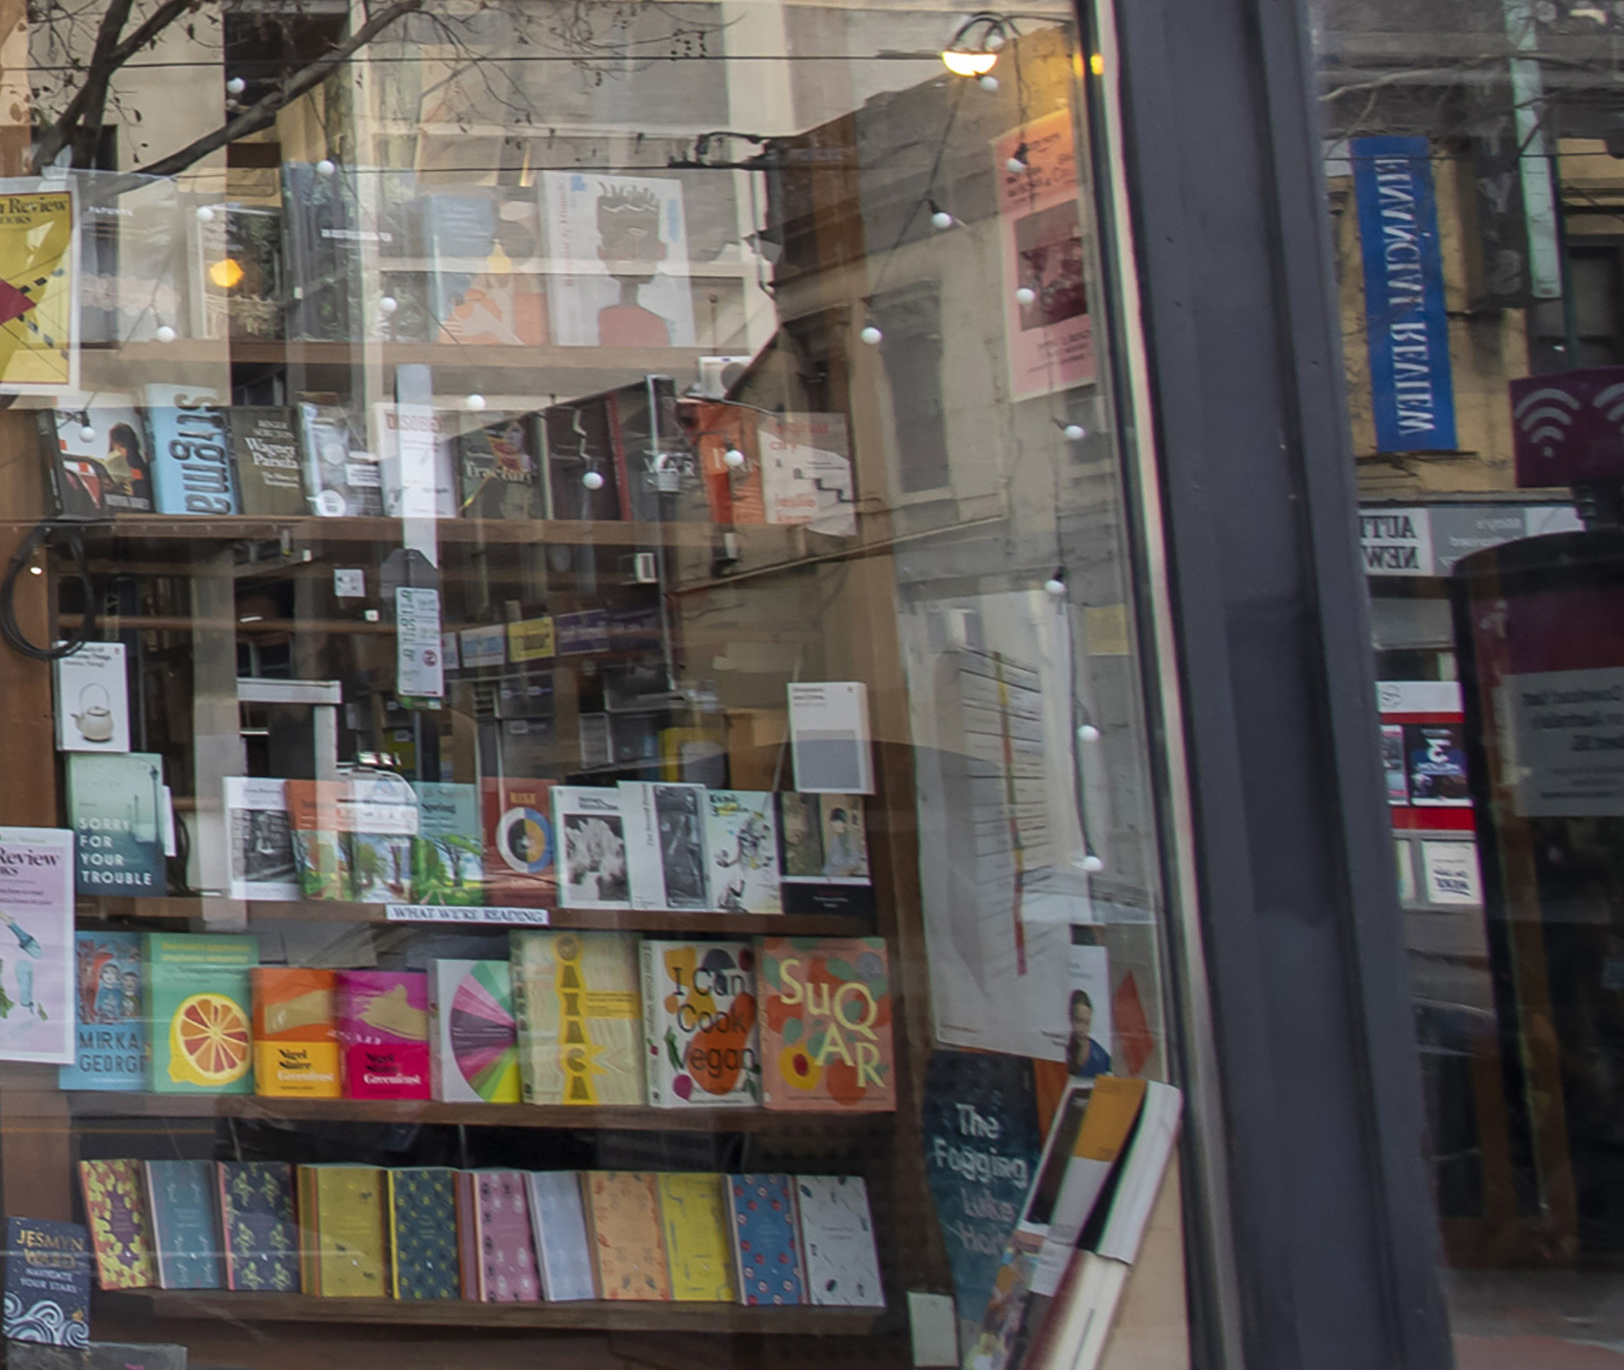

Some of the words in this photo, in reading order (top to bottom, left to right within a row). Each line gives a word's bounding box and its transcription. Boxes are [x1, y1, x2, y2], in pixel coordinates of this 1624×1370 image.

[9, 196, 69, 215] Review
[79, 816, 131, 831] SORRY
[80, 835, 113, 849] FOR
[81, 852, 125, 867] YOUR
[82, 870, 153, 886] TROUBLE
[393, 906, 436, 921] WHAT
[482, 909, 545, 924] READING
[672, 967, 687, 996] I
[692, 967, 749, 997] Can
[677, 1003, 748, 1033] Cook
[79, 1031, 140, 1051] MIRKA
[954, 1102, 1002, 1141] The
[930, 1138, 1029, 1191] Fogging
[959, 1187, 1017, 1220] Luke
[16, 1229, 85, 1252] JESMYN
